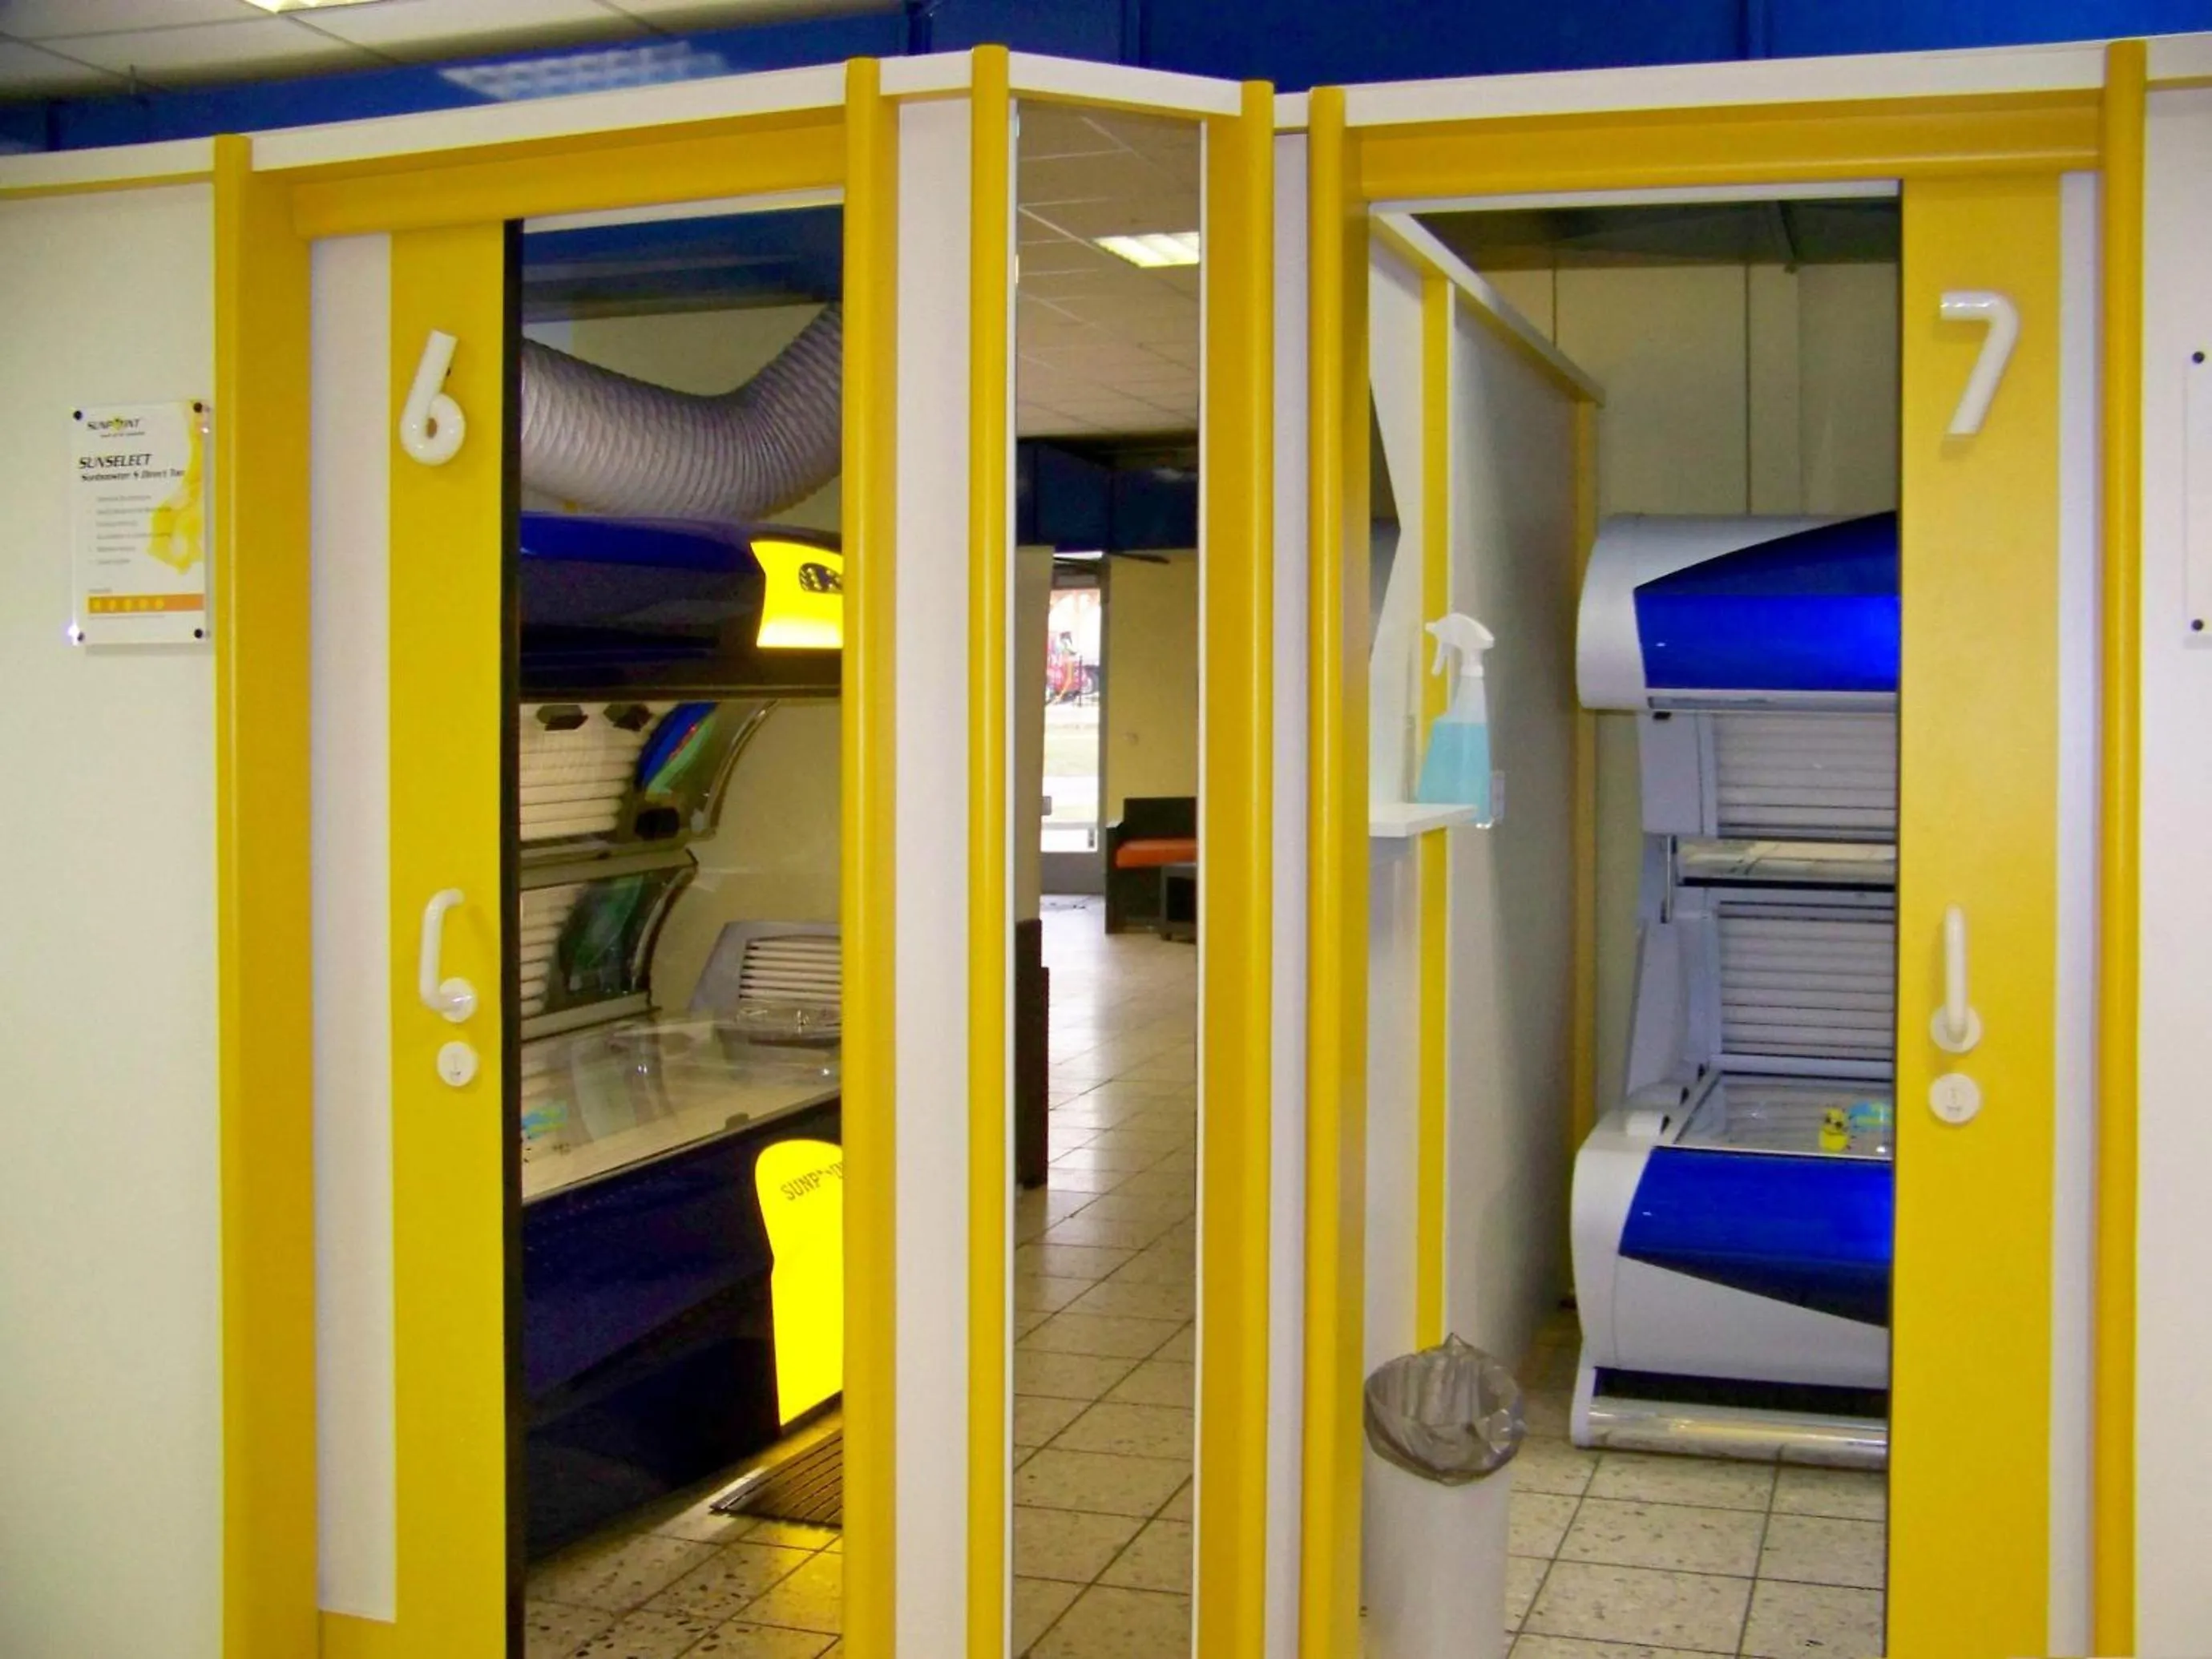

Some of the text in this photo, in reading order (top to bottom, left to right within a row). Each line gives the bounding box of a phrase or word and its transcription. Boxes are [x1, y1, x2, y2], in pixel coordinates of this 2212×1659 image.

[400, 329, 466, 466] 6
[1940, 290, 2020, 434] 7
[79, 453, 152, 470] SUNSELECT
